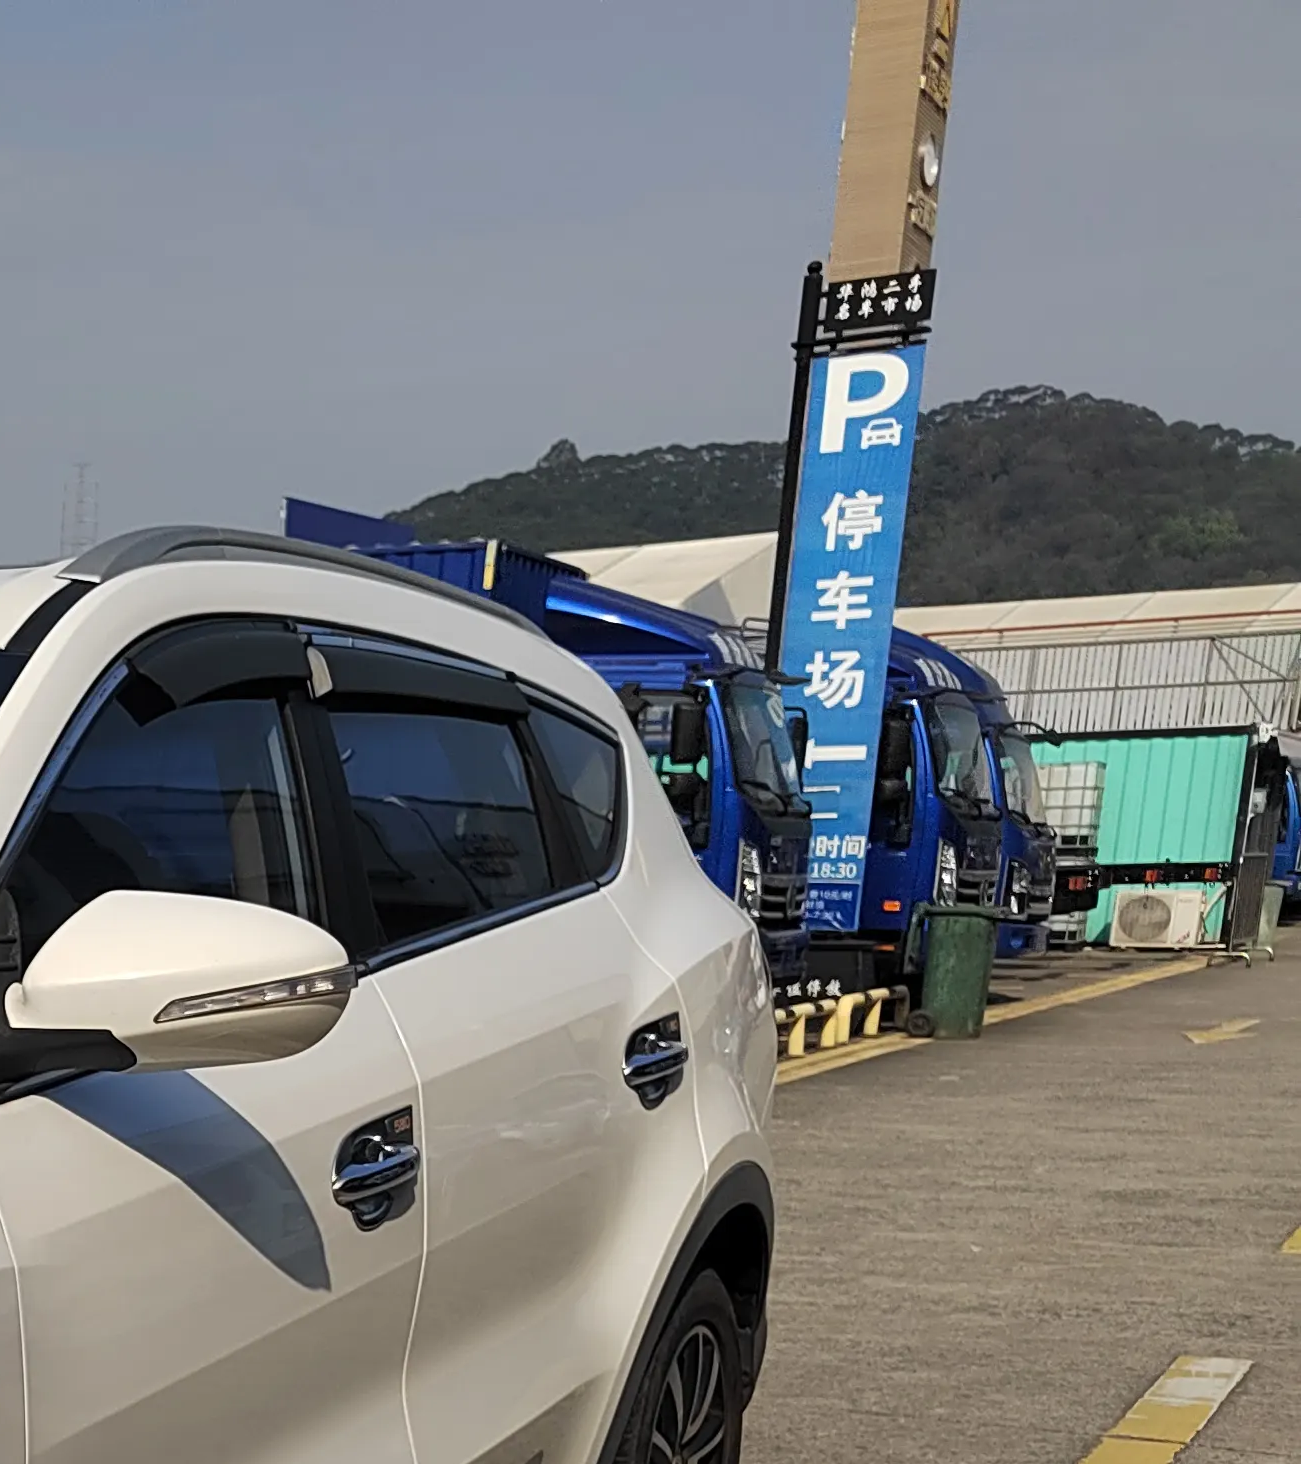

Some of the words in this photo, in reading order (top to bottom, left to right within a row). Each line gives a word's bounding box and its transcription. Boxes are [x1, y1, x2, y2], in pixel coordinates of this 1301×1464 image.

[820, 353, 909, 454] P
[803, 488, 885, 709] 停车场
[810, 834, 866, 859] 时间
